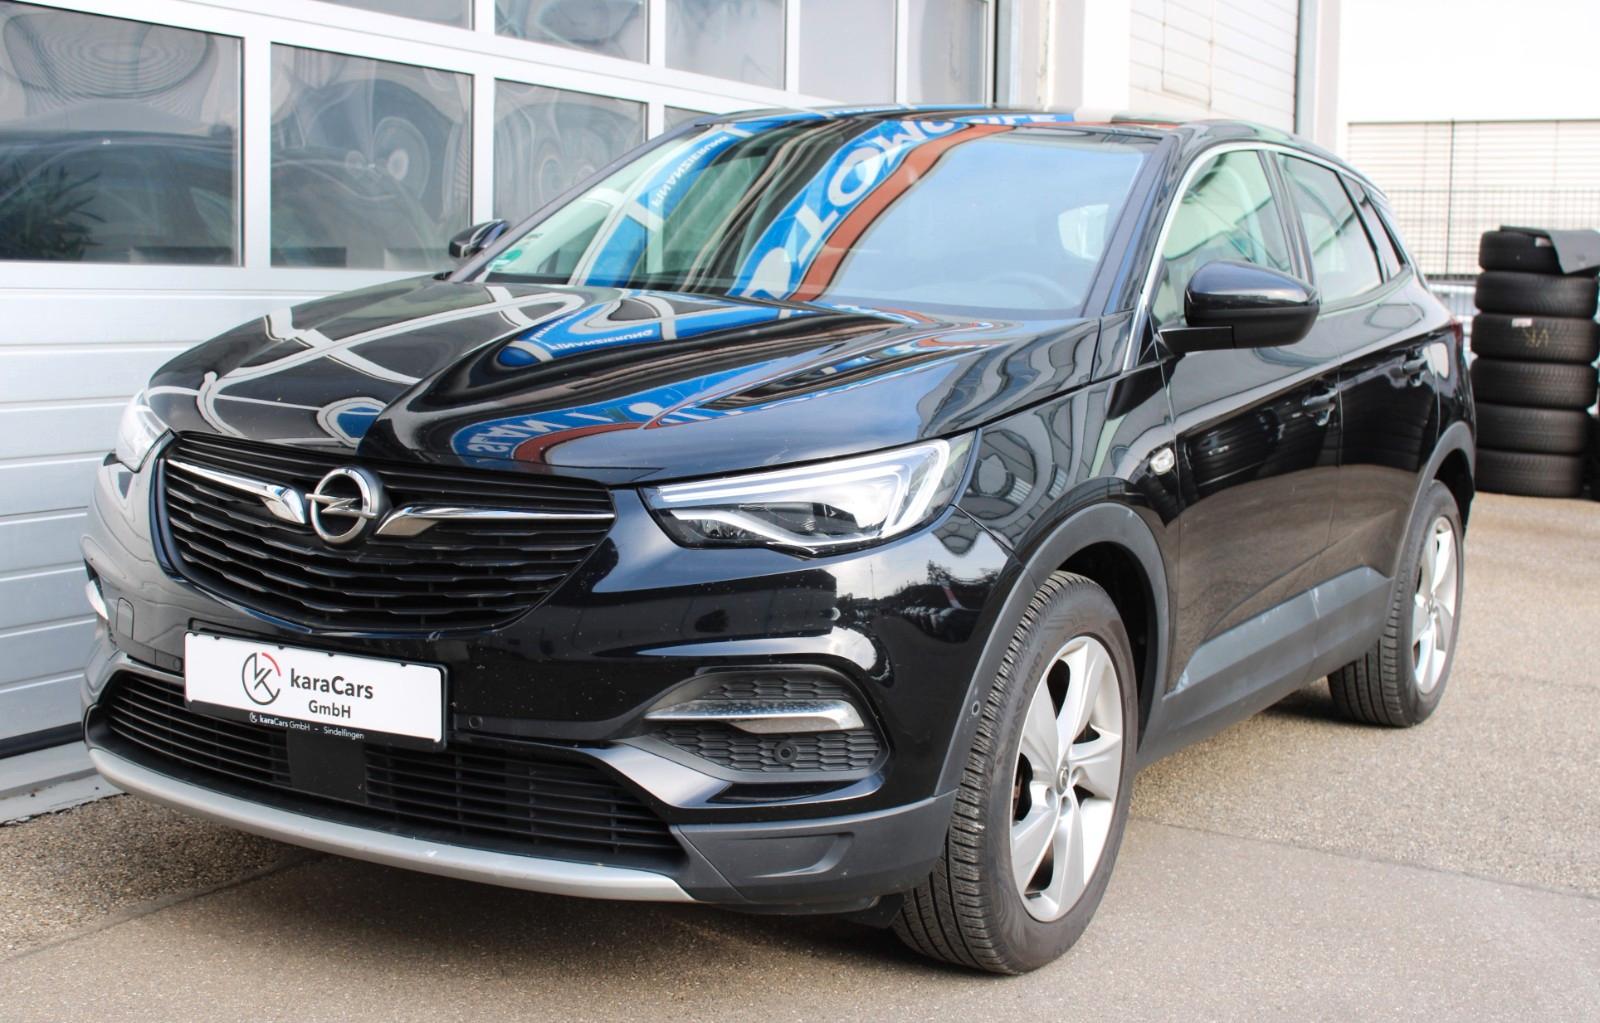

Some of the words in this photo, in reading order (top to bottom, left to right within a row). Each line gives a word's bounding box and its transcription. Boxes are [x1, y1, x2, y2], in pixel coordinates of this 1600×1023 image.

[290, 667, 374, 700] karaCars
[308, 699, 352, 719] GmbH
[259, 714, 289, 728] karaCars
[289, 720, 311, 732] GmbH
[323, 726, 365, 741] Sindelfingen
